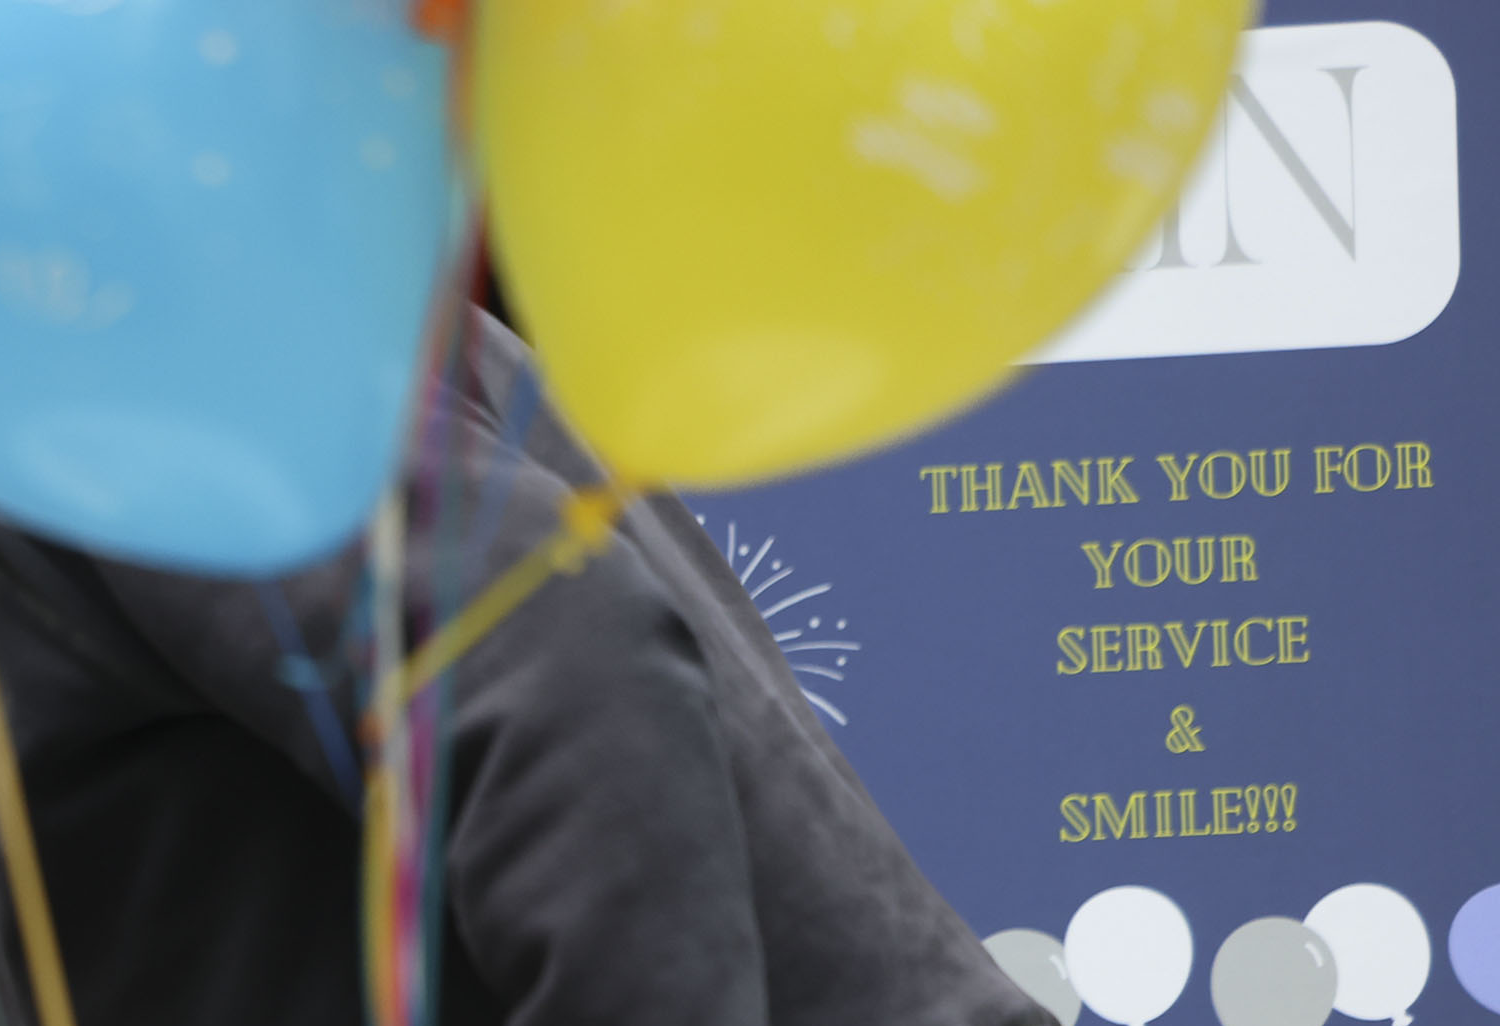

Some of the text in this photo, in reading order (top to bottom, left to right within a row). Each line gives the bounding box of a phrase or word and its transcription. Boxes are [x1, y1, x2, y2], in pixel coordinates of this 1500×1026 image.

[920, 441, 1435, 514] THANK YOU FOR
[1081, 535, 1259, 589] YOUR
[1056, 616, 1311, 675] SERVICE
[1165, 704, 1205, 754] &
[1059, 784, 1298, 843] SMILE!!!
